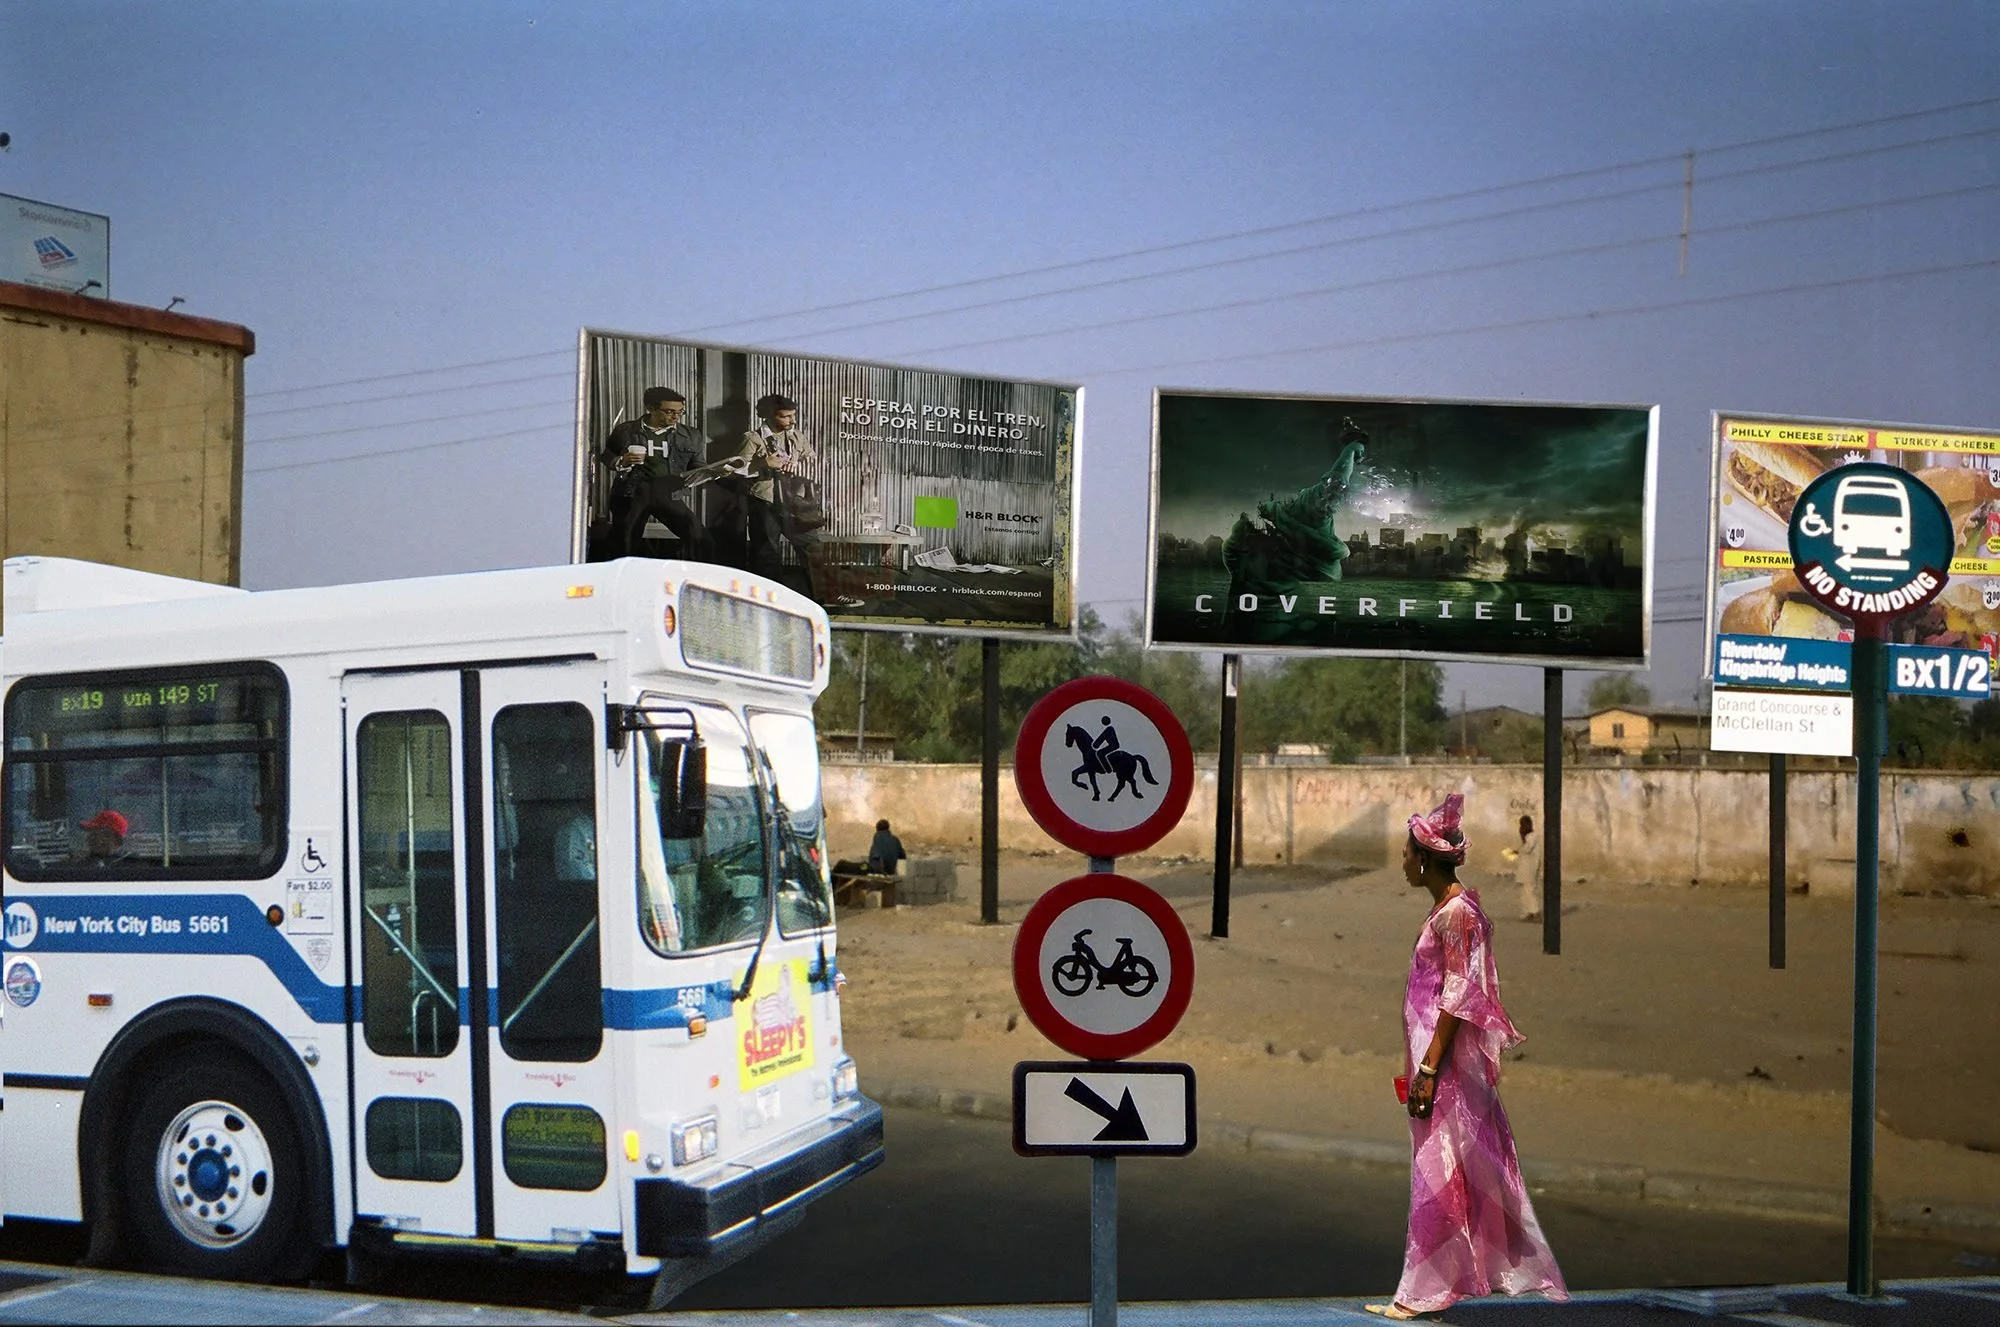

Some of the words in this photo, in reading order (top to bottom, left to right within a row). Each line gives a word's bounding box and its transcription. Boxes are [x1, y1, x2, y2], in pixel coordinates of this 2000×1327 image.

[841, 396, 915, 415] ESPERA
[923, 404, 960, 419] POR
[968, 409, 988, 422] EL
[993, 411, 1046, 430] TREN,
[841, 411, 871, 425] NO
[879, 415, 918, 430] POR
[926, 420, 946, 433] EL
[953, 422, 1029, 440] DINERO.
[1731, 427, 1771, 438] PHILLY
[1778, 430, 1823, 441] CHEESE
[1827, 432, 1865, 443] STEAK
[647, 439, 669, 458] H
[839, 431, 883, 443] Opciones
[886, 435, 898, 444] de
[899, 437, 930, 447] dinero
[932, 440, 962, 449] rápido
[977, 442, 1004, 453] época
[1005, 446, 1017, 454] de
[1019, 447, 1045, 457] taxes.
[1893, 436, 1938, 447] TURKEY
[1942, 439, 1949, 448] &
[1953, 440, 1995, 450] CHEESE
[965, 510, 993, 521] H&R
[984, 526, 1013, 534] Estamos
[1014, 529, 1040, 537] contigo
[1743, 555, 1793, 565] PASTRAMI
[1954, 562, 1988, 571] CHEESE
[865, 583, 937, 593] 1-800-HRBLOCK
[952, 587, 1042, 598] hrblock.com/espanol
[1805, 565, 1836, 595] NO
[1835, 571, 1938, 613] STANDING
[1194, 593, 1574, 623] COVERFIELD
[1720, 640, 1787, 661] Riverdale/
[1719, 659, 1796, 683] Kingsbridge
[1797, 663, 1847, 685] Heights
[1897, 654, 1988, 692] BX1/2
[123, 693, 151, 706] VIA
[159, 686, 190, 705] 149
[197, 683, 219, 702] ST
[1717, 697, 1756, 713] Grand
[1759, 698, 1828, 715] Concourse
[1832, 703, 1841, 716] &
[1716, 715, 1793, 732] McClellan
[1799, 719, 1814, 733] St
[287, 882, 305, 891] Fare
[307, 881, 332, 891] $2.00
[44, 916, 77, 933] New
[80, 916, 114, 933] York
[117, 915, 148, 936] City
[151, 916, 182, 933] Bus
[189, 916, 229, 933] 5661
